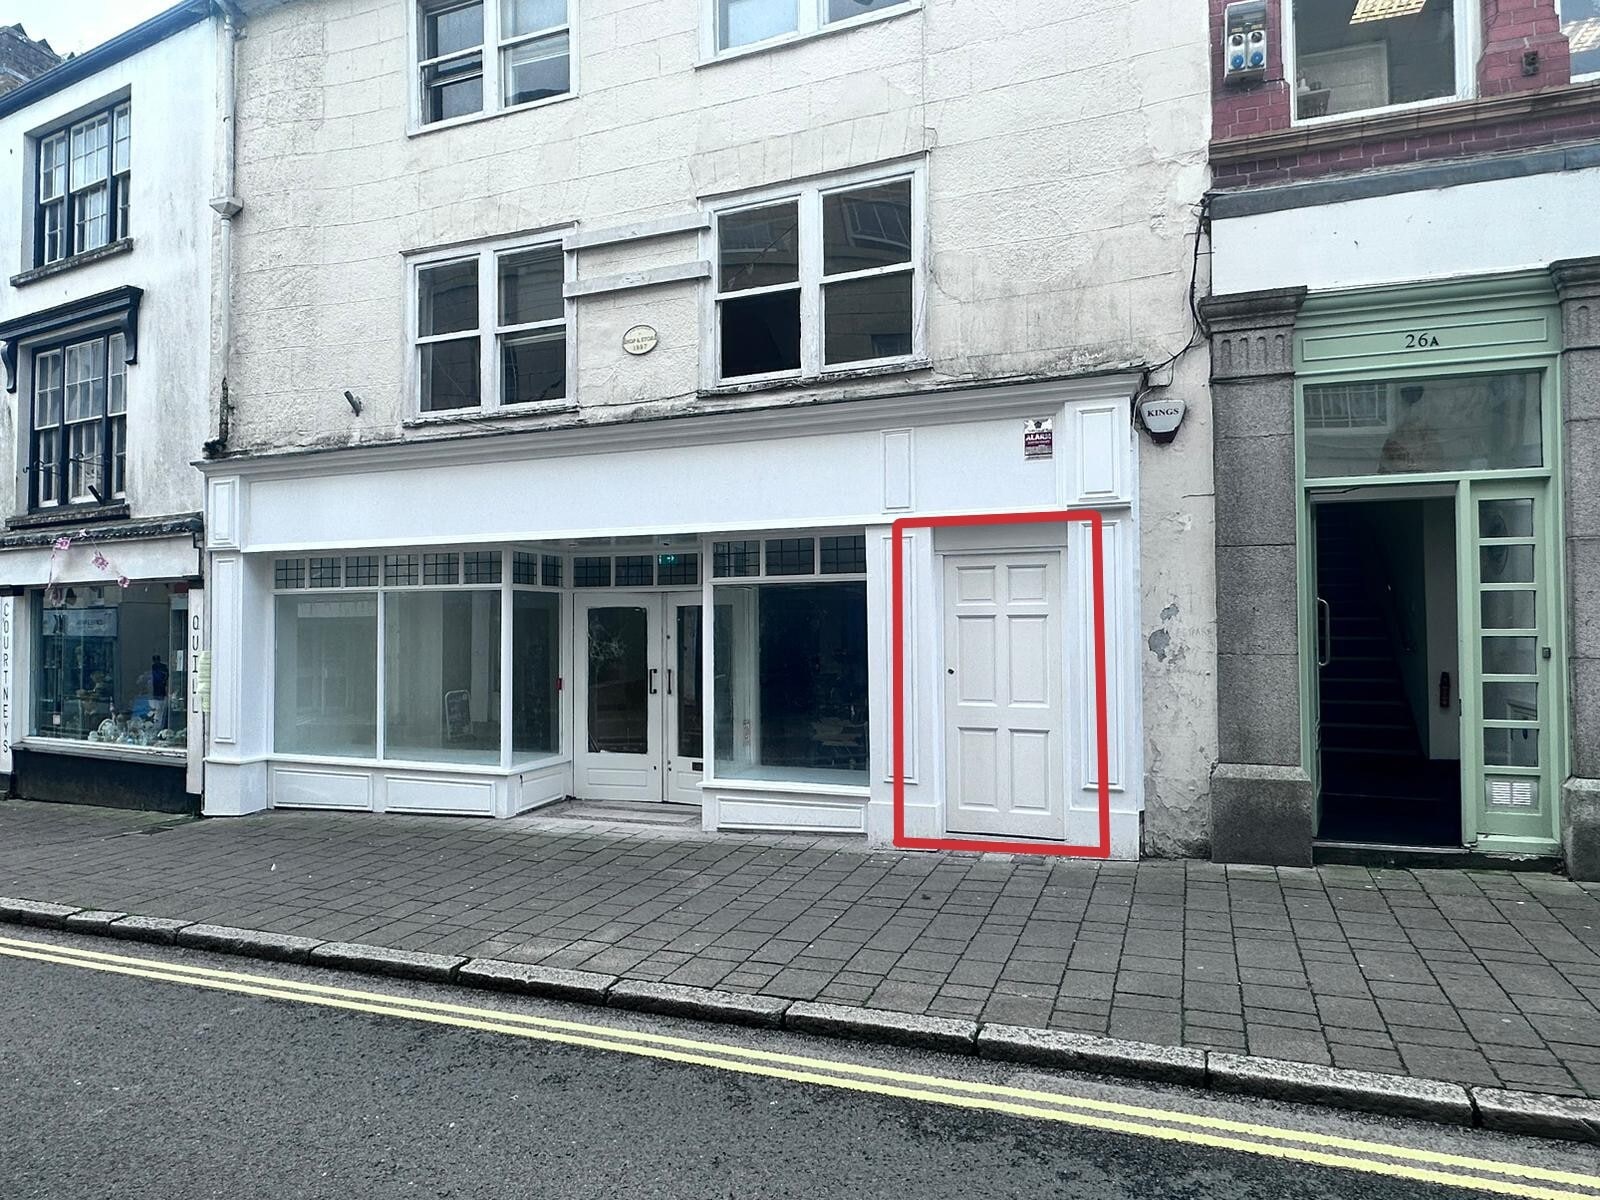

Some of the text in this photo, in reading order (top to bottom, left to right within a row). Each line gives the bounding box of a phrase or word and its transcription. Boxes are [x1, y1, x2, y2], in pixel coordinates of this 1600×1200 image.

[1405, 332, 1440, 349] 26A
[1147, 408, 1179, 417] KINGS
[2, 602, 11, 754] COURTNEYS
[192, 614, 200, 714] QUILL
